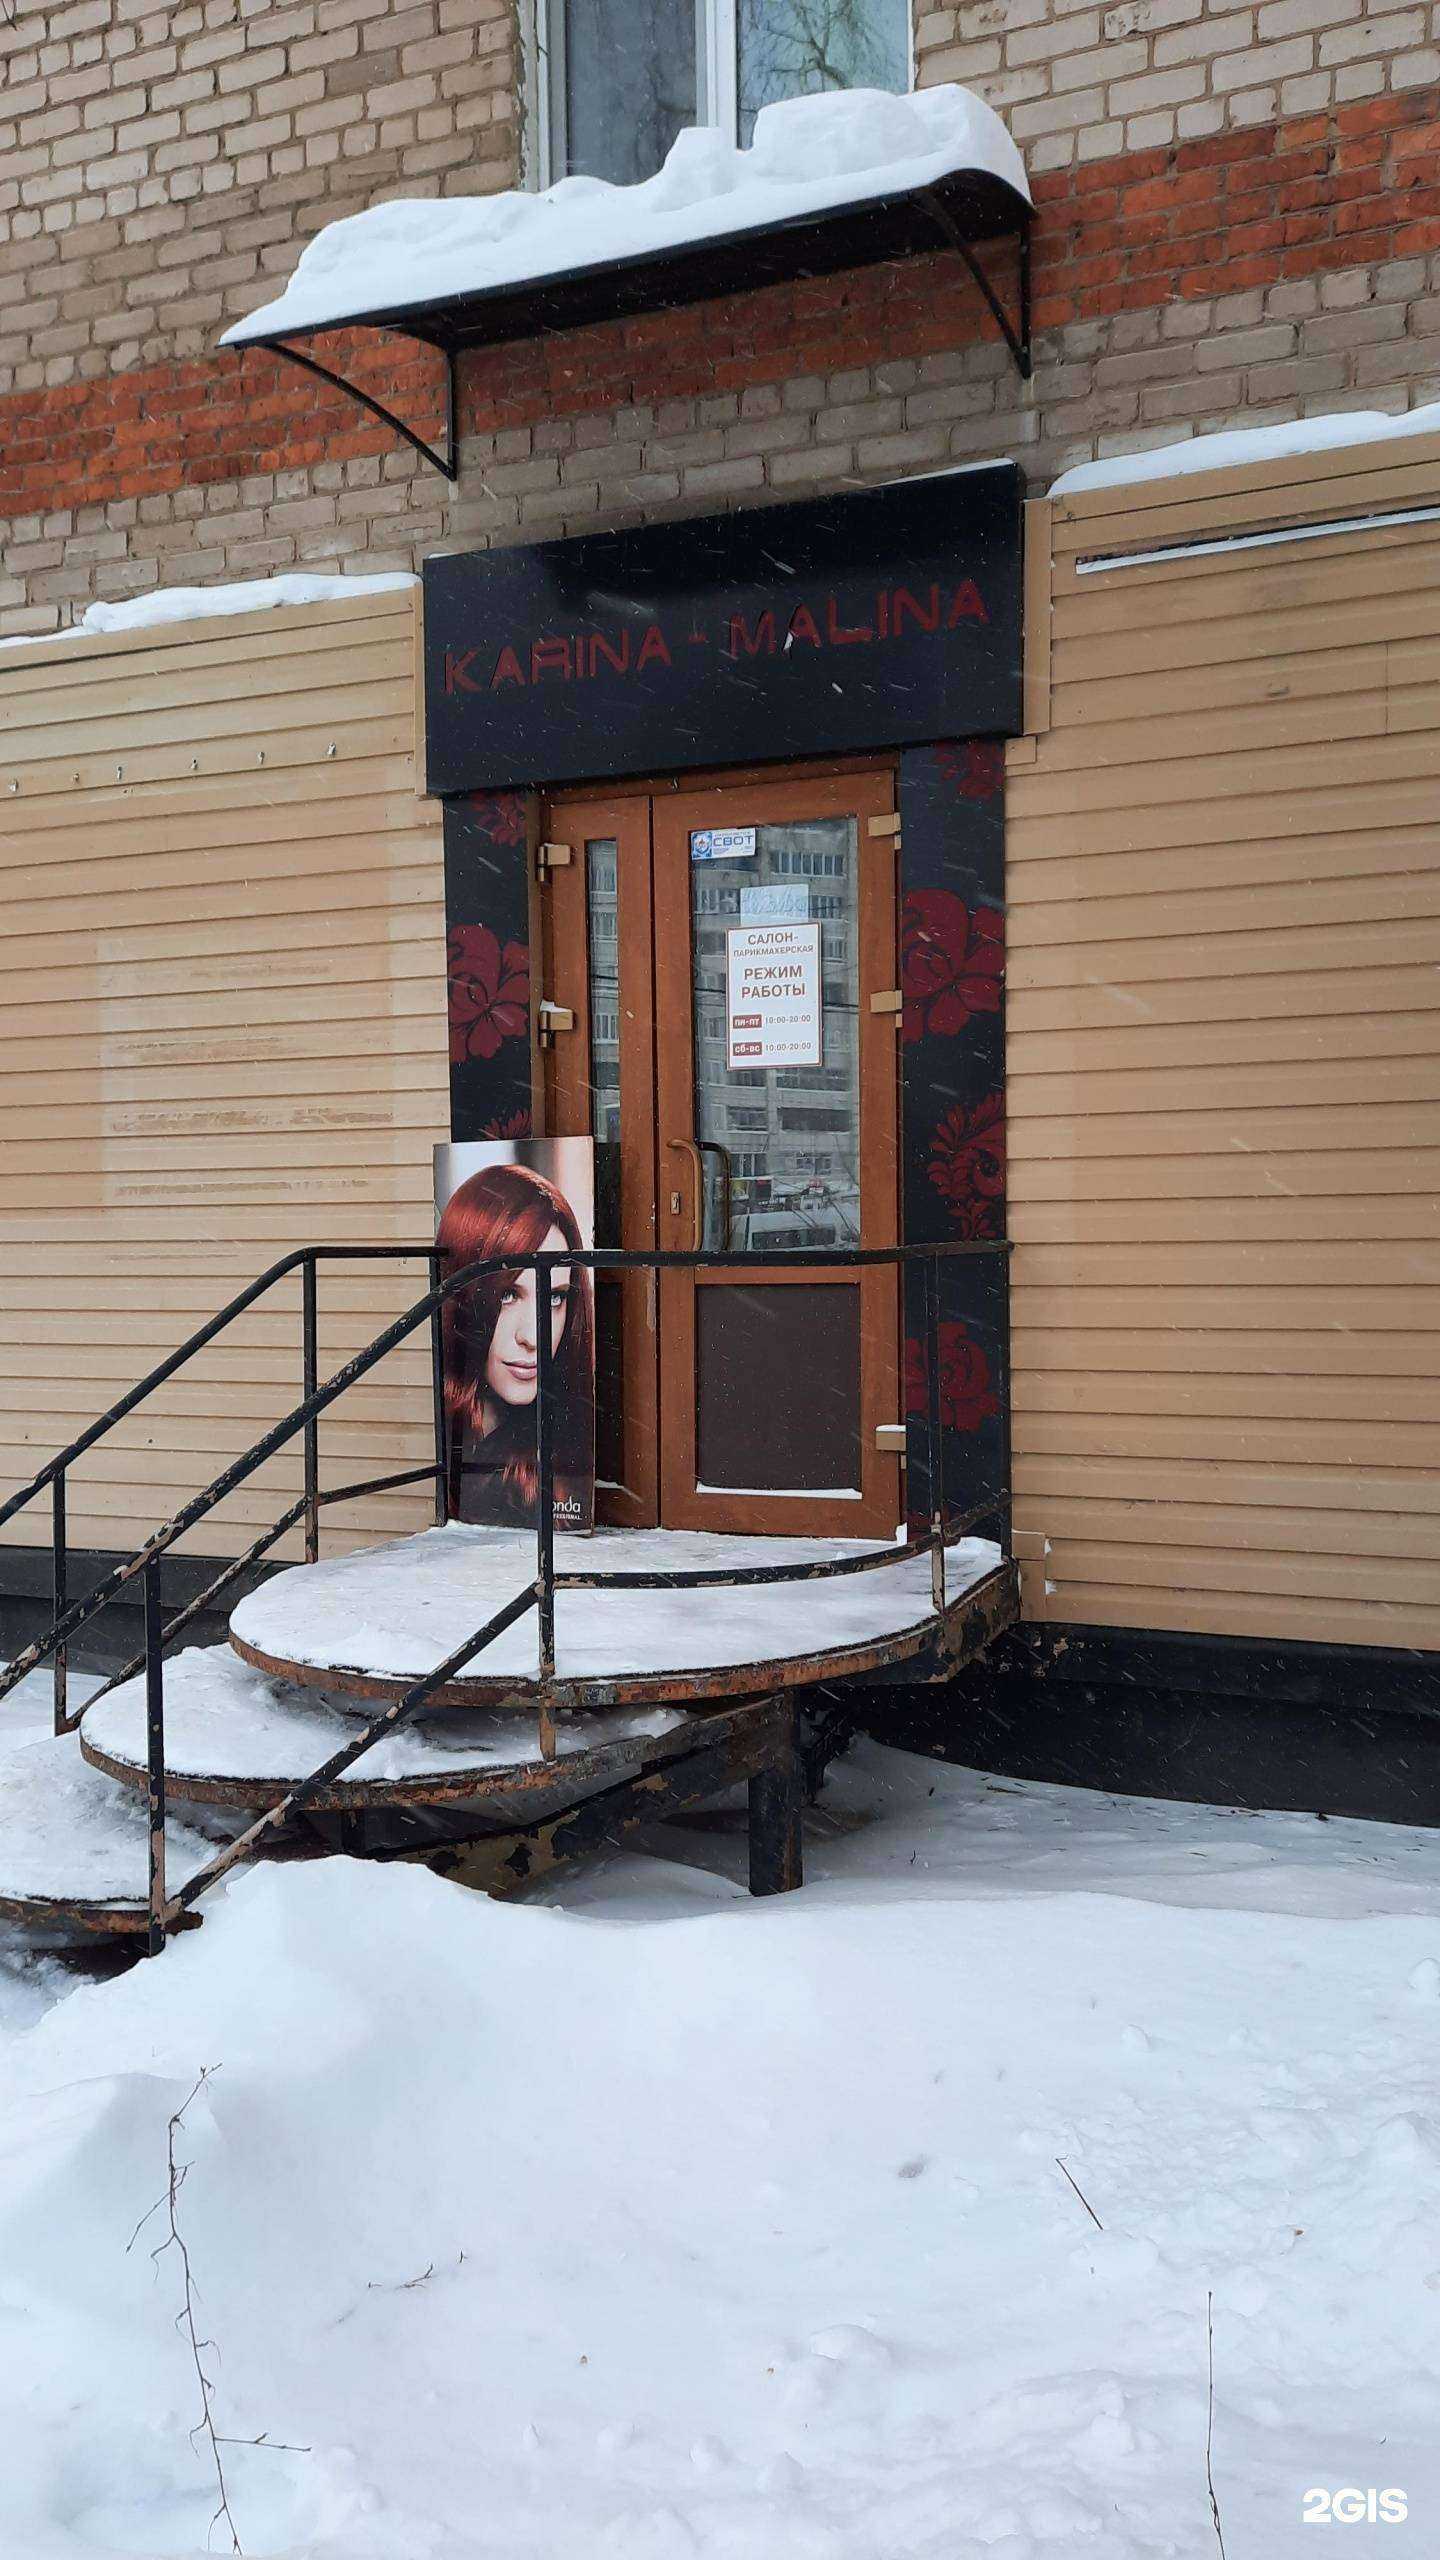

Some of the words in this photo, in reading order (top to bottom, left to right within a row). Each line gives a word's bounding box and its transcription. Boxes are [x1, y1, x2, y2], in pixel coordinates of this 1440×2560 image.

[443, 625, 672, 694] KARINA
[729, 579, 989, 660] MALINA
[747, 932, 799, 945] САЛОН-
[733, 945, 814, 957] ПАРИКМАХЕРСКАЯ
[744, 965, 803, 980] РЕЖИМ
[741, 983, 806, 999] РАБОТЫ
